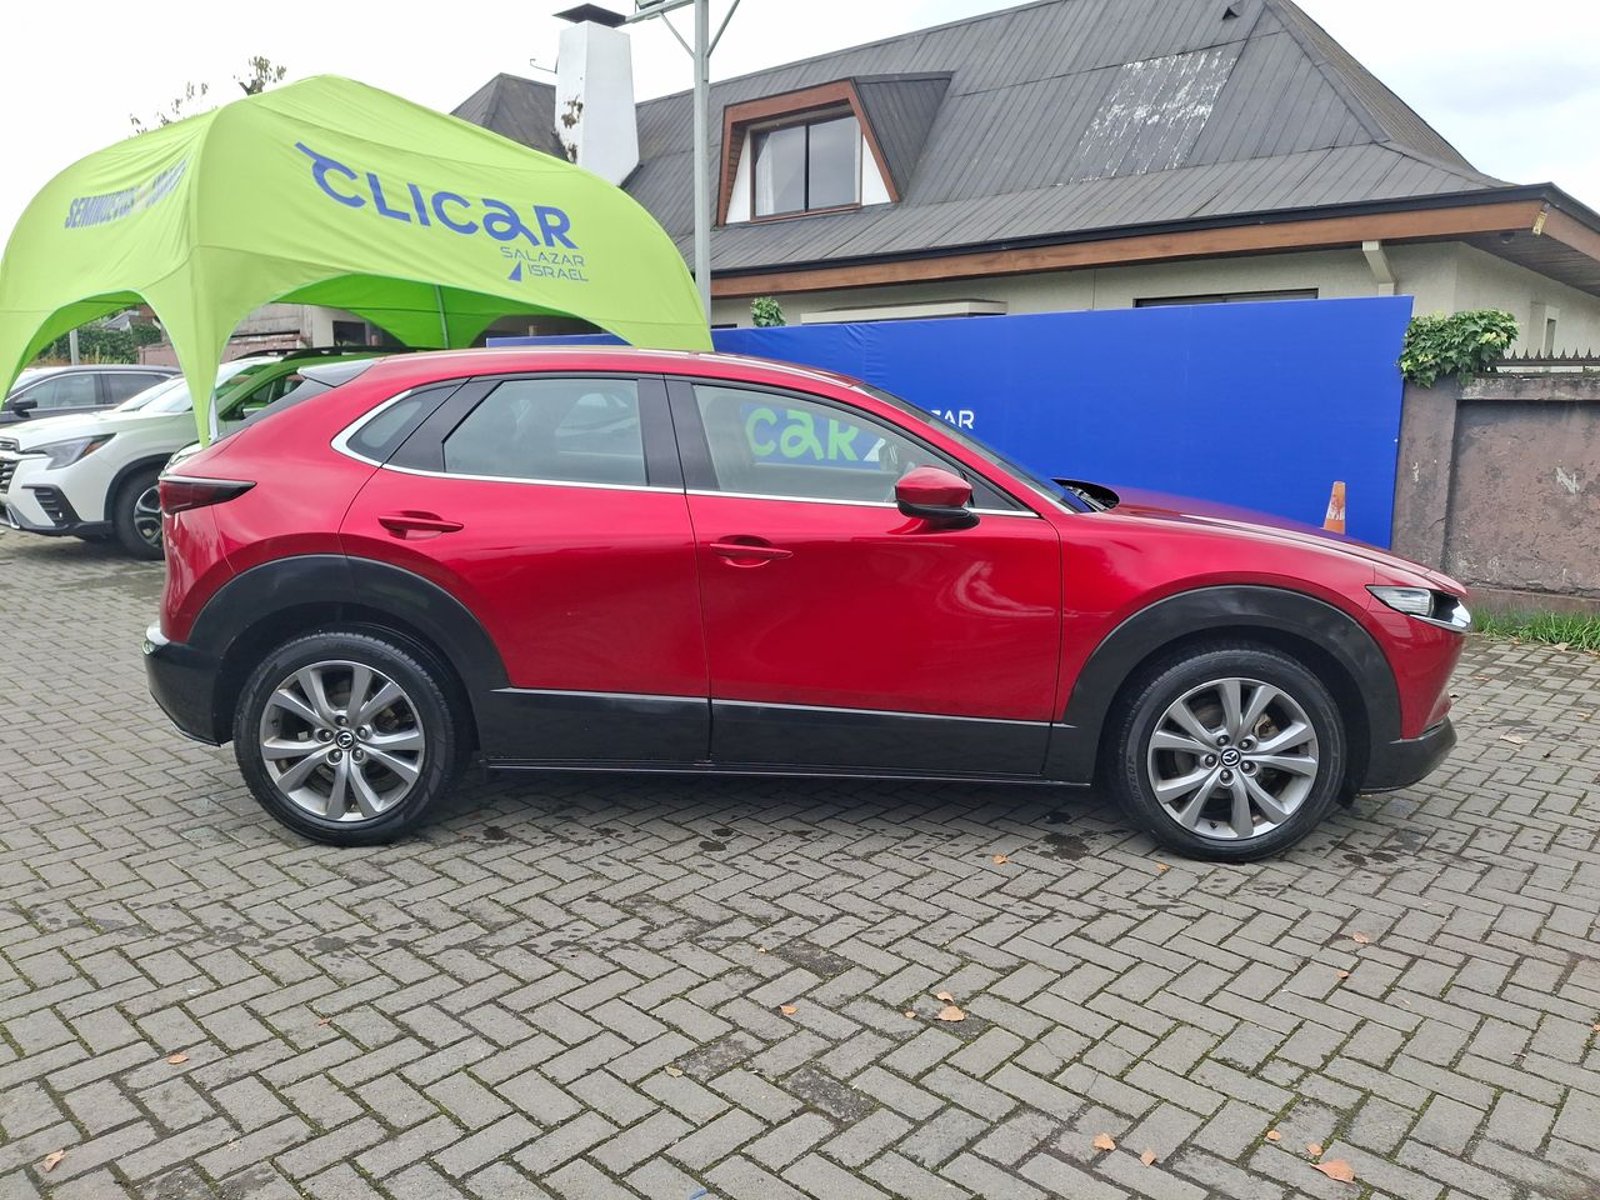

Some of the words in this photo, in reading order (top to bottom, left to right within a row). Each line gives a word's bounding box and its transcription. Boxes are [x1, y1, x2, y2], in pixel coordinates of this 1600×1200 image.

[500, 246, 584, 267] SALAZAR
[528, 264, 588, 282] ISRAEL
[931, 409, 975, 430] AR
